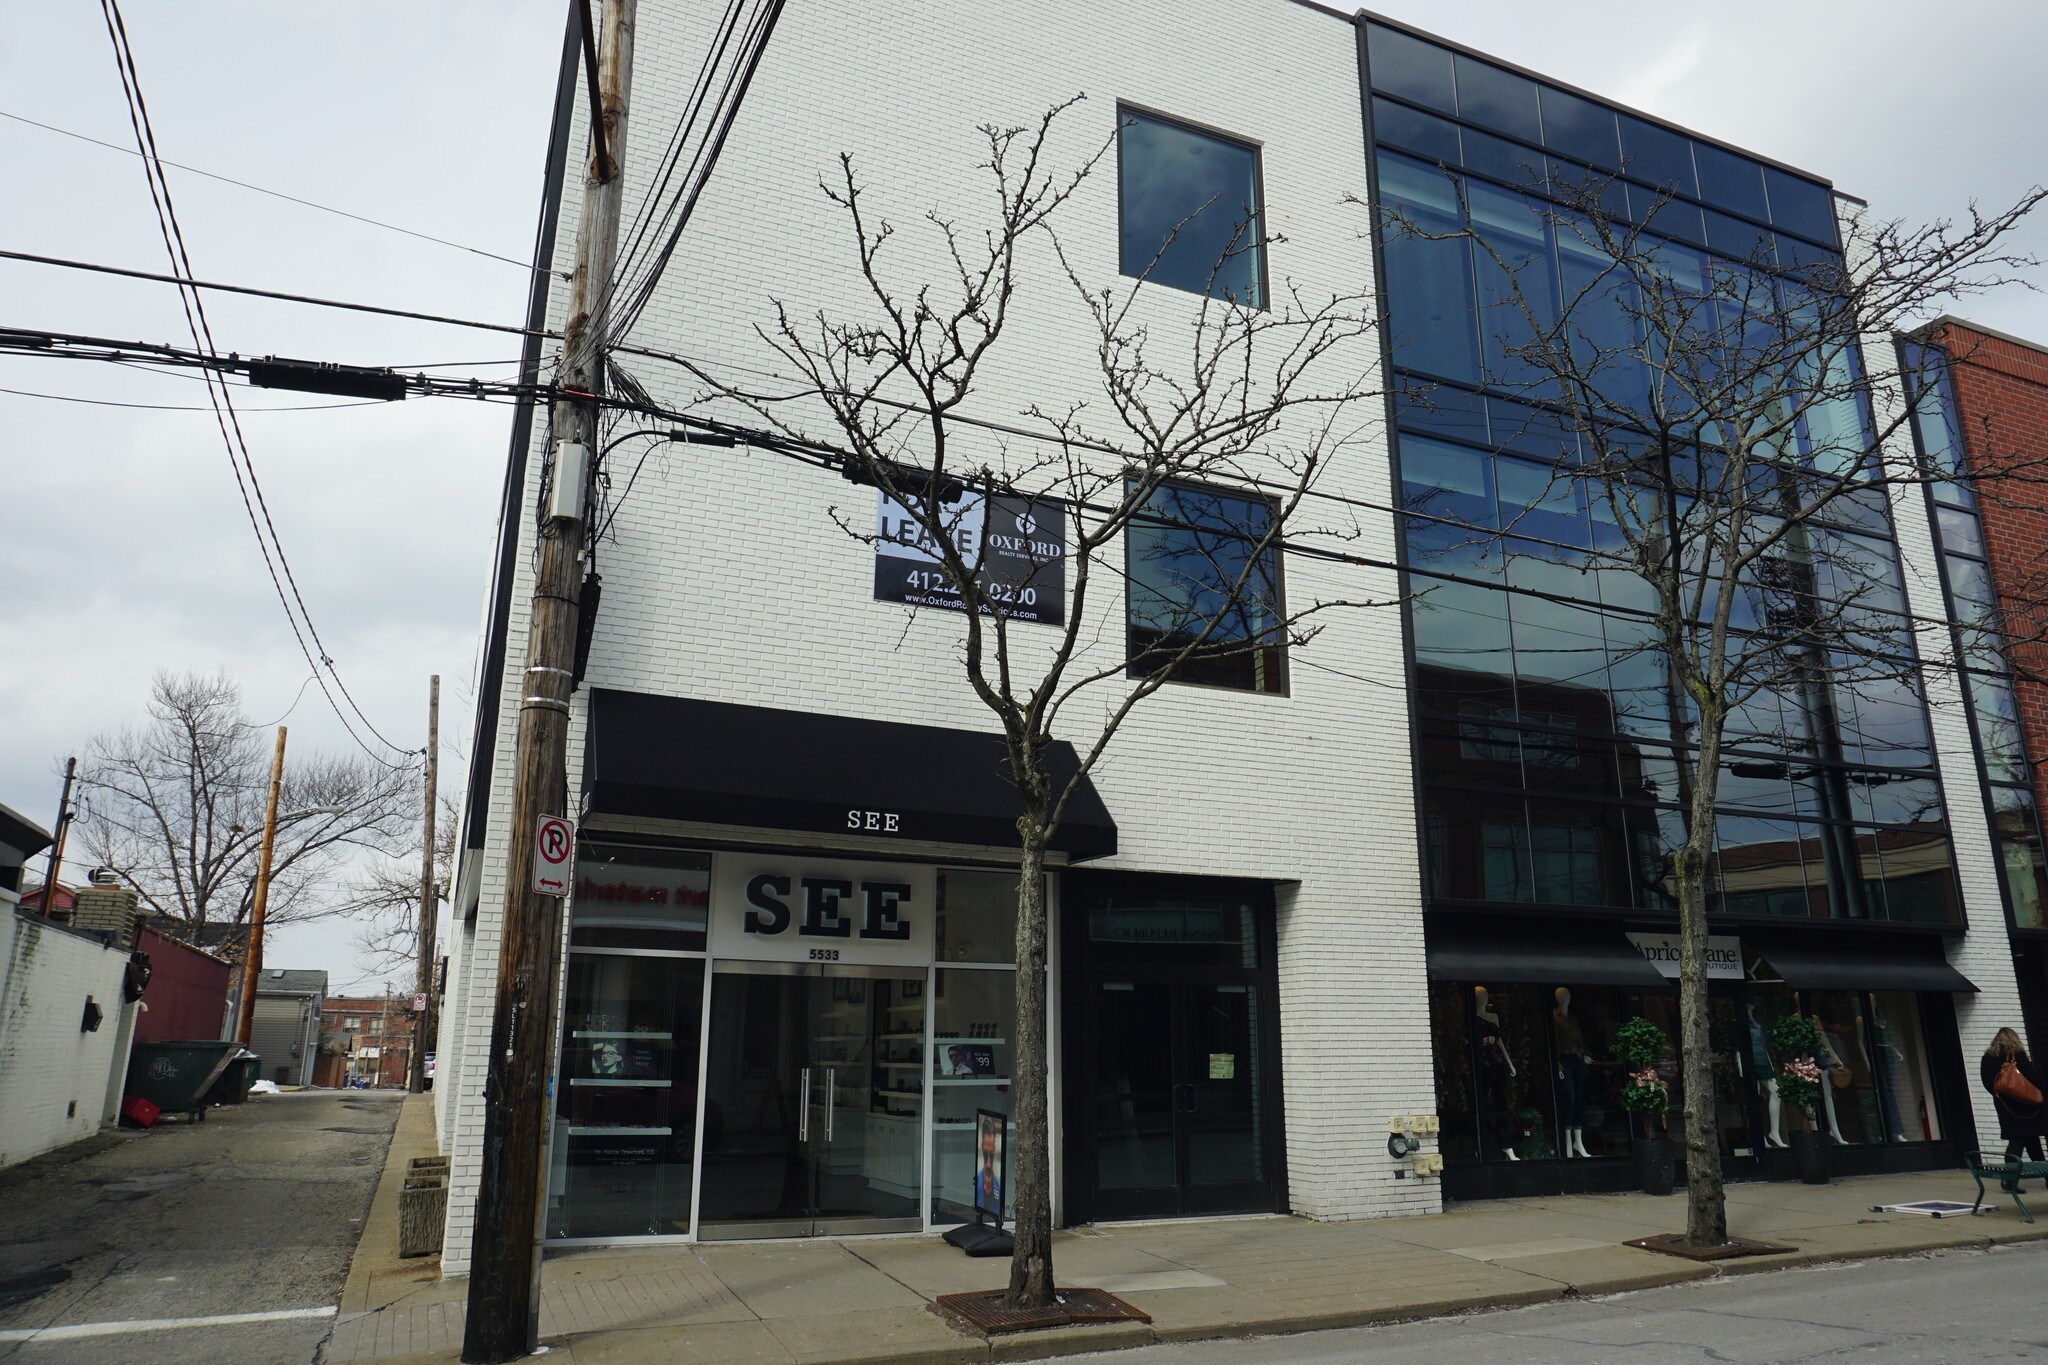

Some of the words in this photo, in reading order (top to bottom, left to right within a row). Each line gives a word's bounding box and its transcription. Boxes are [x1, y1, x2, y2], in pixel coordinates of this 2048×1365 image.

[882, 516, 973, 554] LEAE
[847, 810, 900, 832] SEE
[744, 874, 911, 940] SEE
[810, 949, 839, 961] 5533
[1705, 949, 1737, 962] ane
